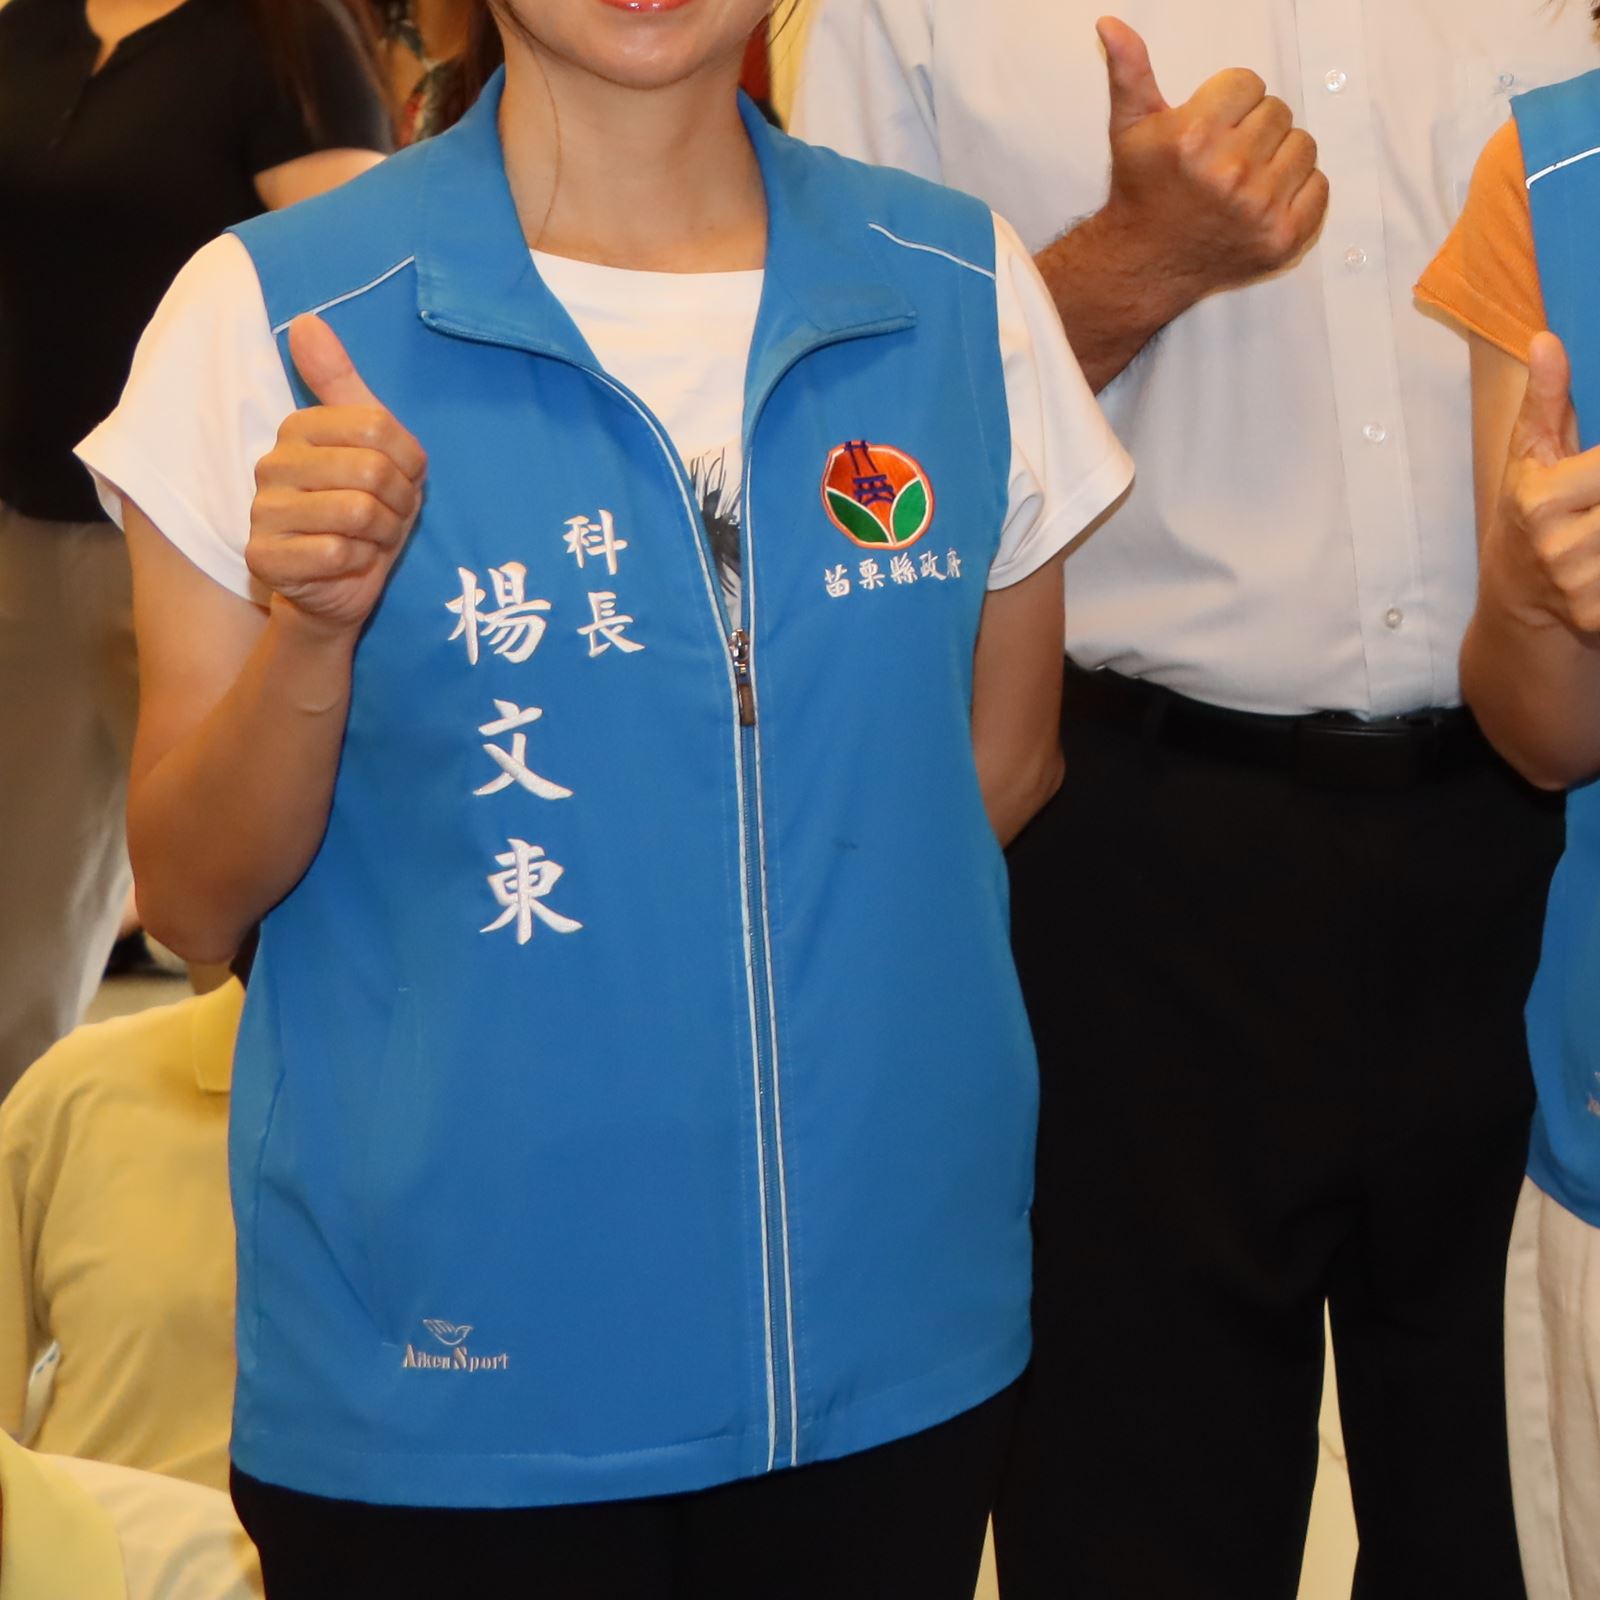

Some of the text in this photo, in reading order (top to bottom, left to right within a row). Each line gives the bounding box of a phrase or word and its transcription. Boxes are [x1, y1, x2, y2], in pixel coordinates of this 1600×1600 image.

[563, 509, 645, 658] 科長
[825, 548, 962, 598] 苗栗縣政府
[445, 561, 583, 945] 楊文東
